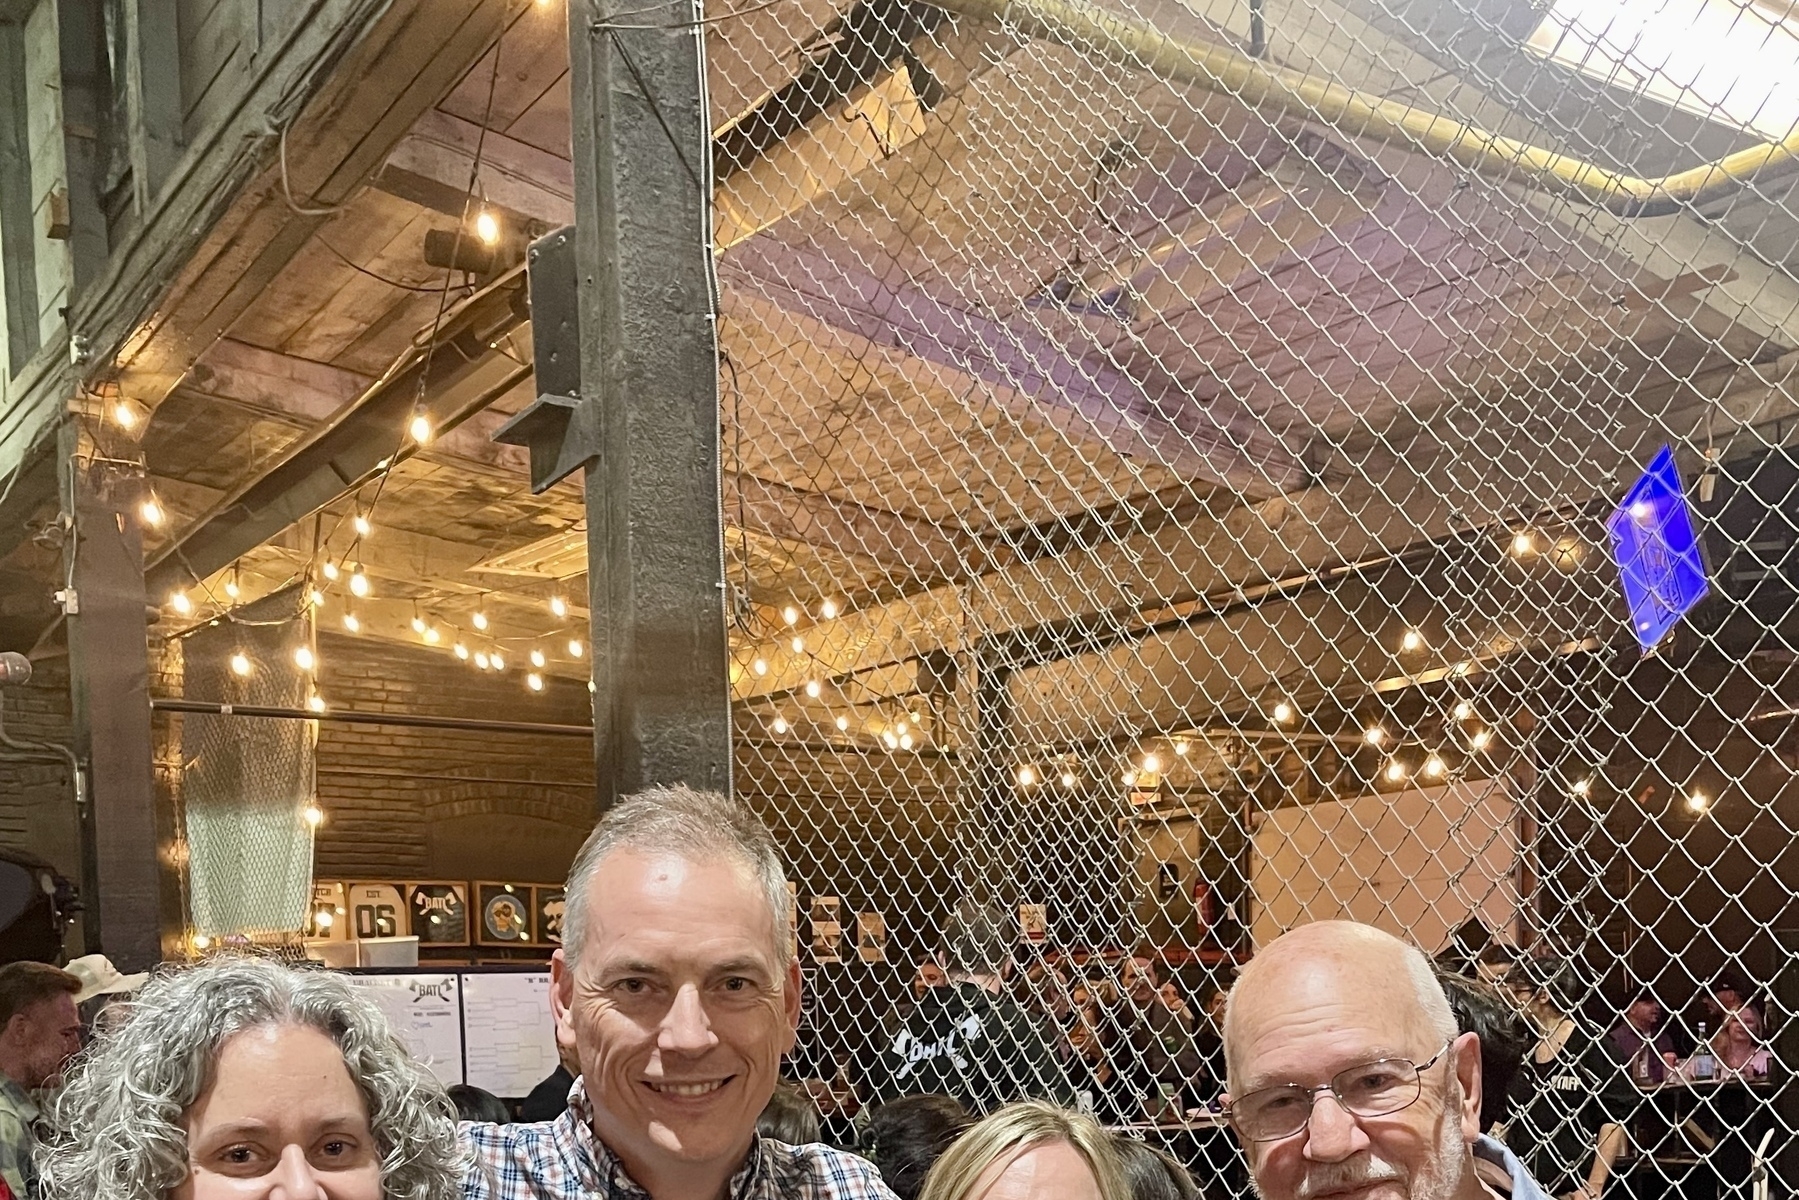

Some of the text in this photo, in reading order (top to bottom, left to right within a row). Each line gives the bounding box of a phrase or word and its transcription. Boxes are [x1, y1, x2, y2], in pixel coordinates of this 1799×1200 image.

[355, 904, 396, 938] 06
[419, 984, 443, 997] BATL
[1551, 1075, 1581, 1091] STAFF
